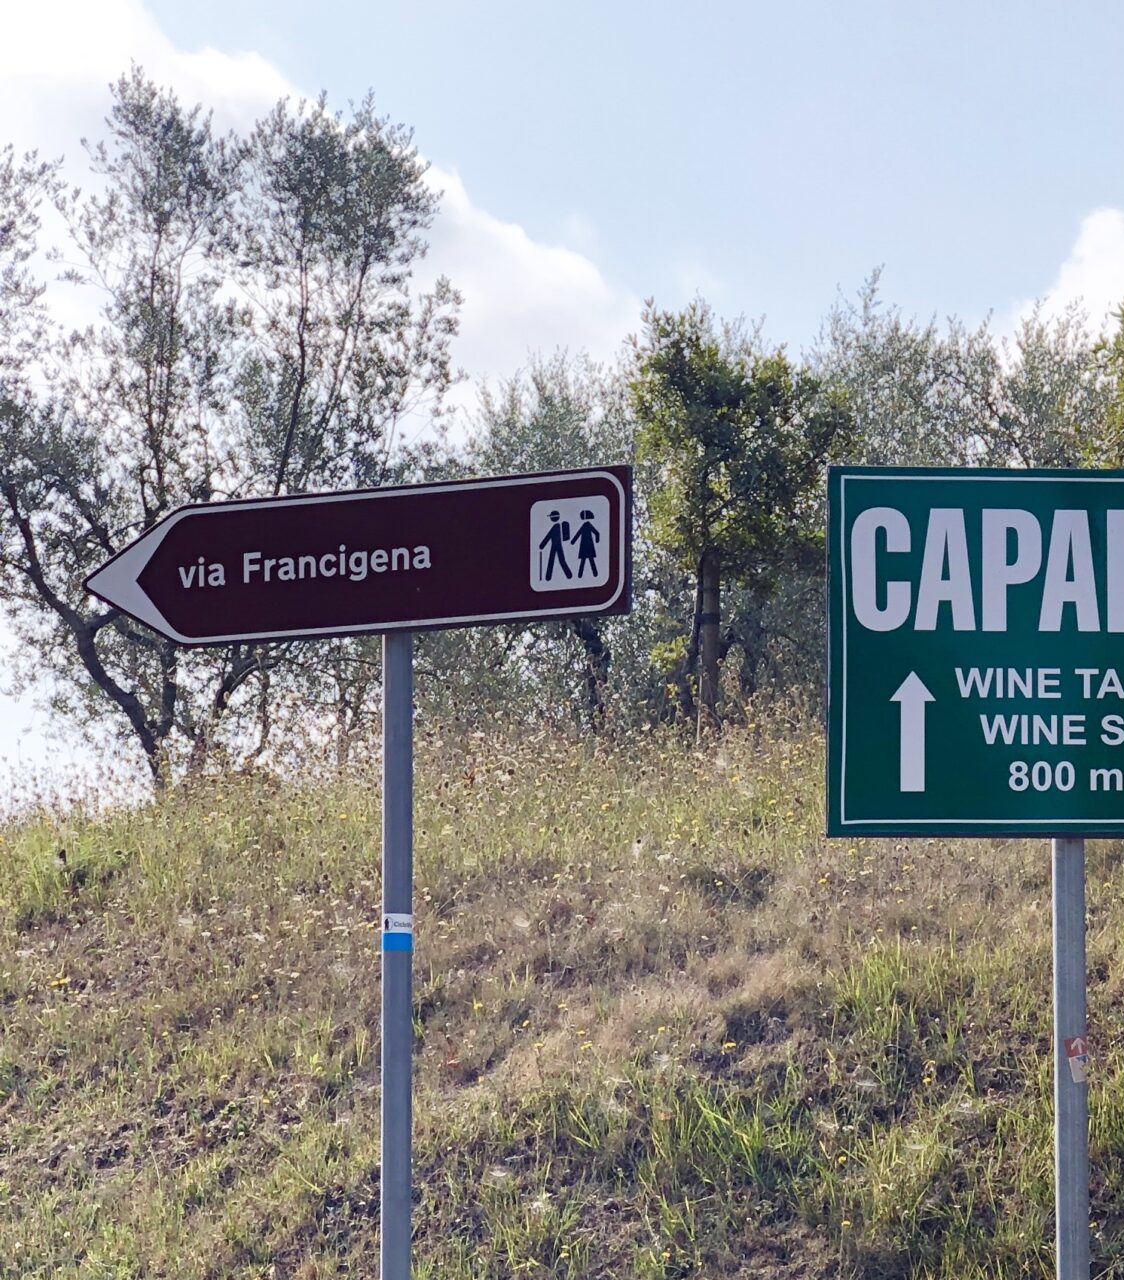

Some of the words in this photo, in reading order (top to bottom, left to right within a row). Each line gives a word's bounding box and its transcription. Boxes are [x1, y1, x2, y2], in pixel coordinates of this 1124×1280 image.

[178, 556, 226, 589] via
[243, 544, 432, 583] Francigena
[955, 667, 1062, 699] WINE
[980, 714, 1087, 745] WINE
[1008, 760, 1076, 792] 800
